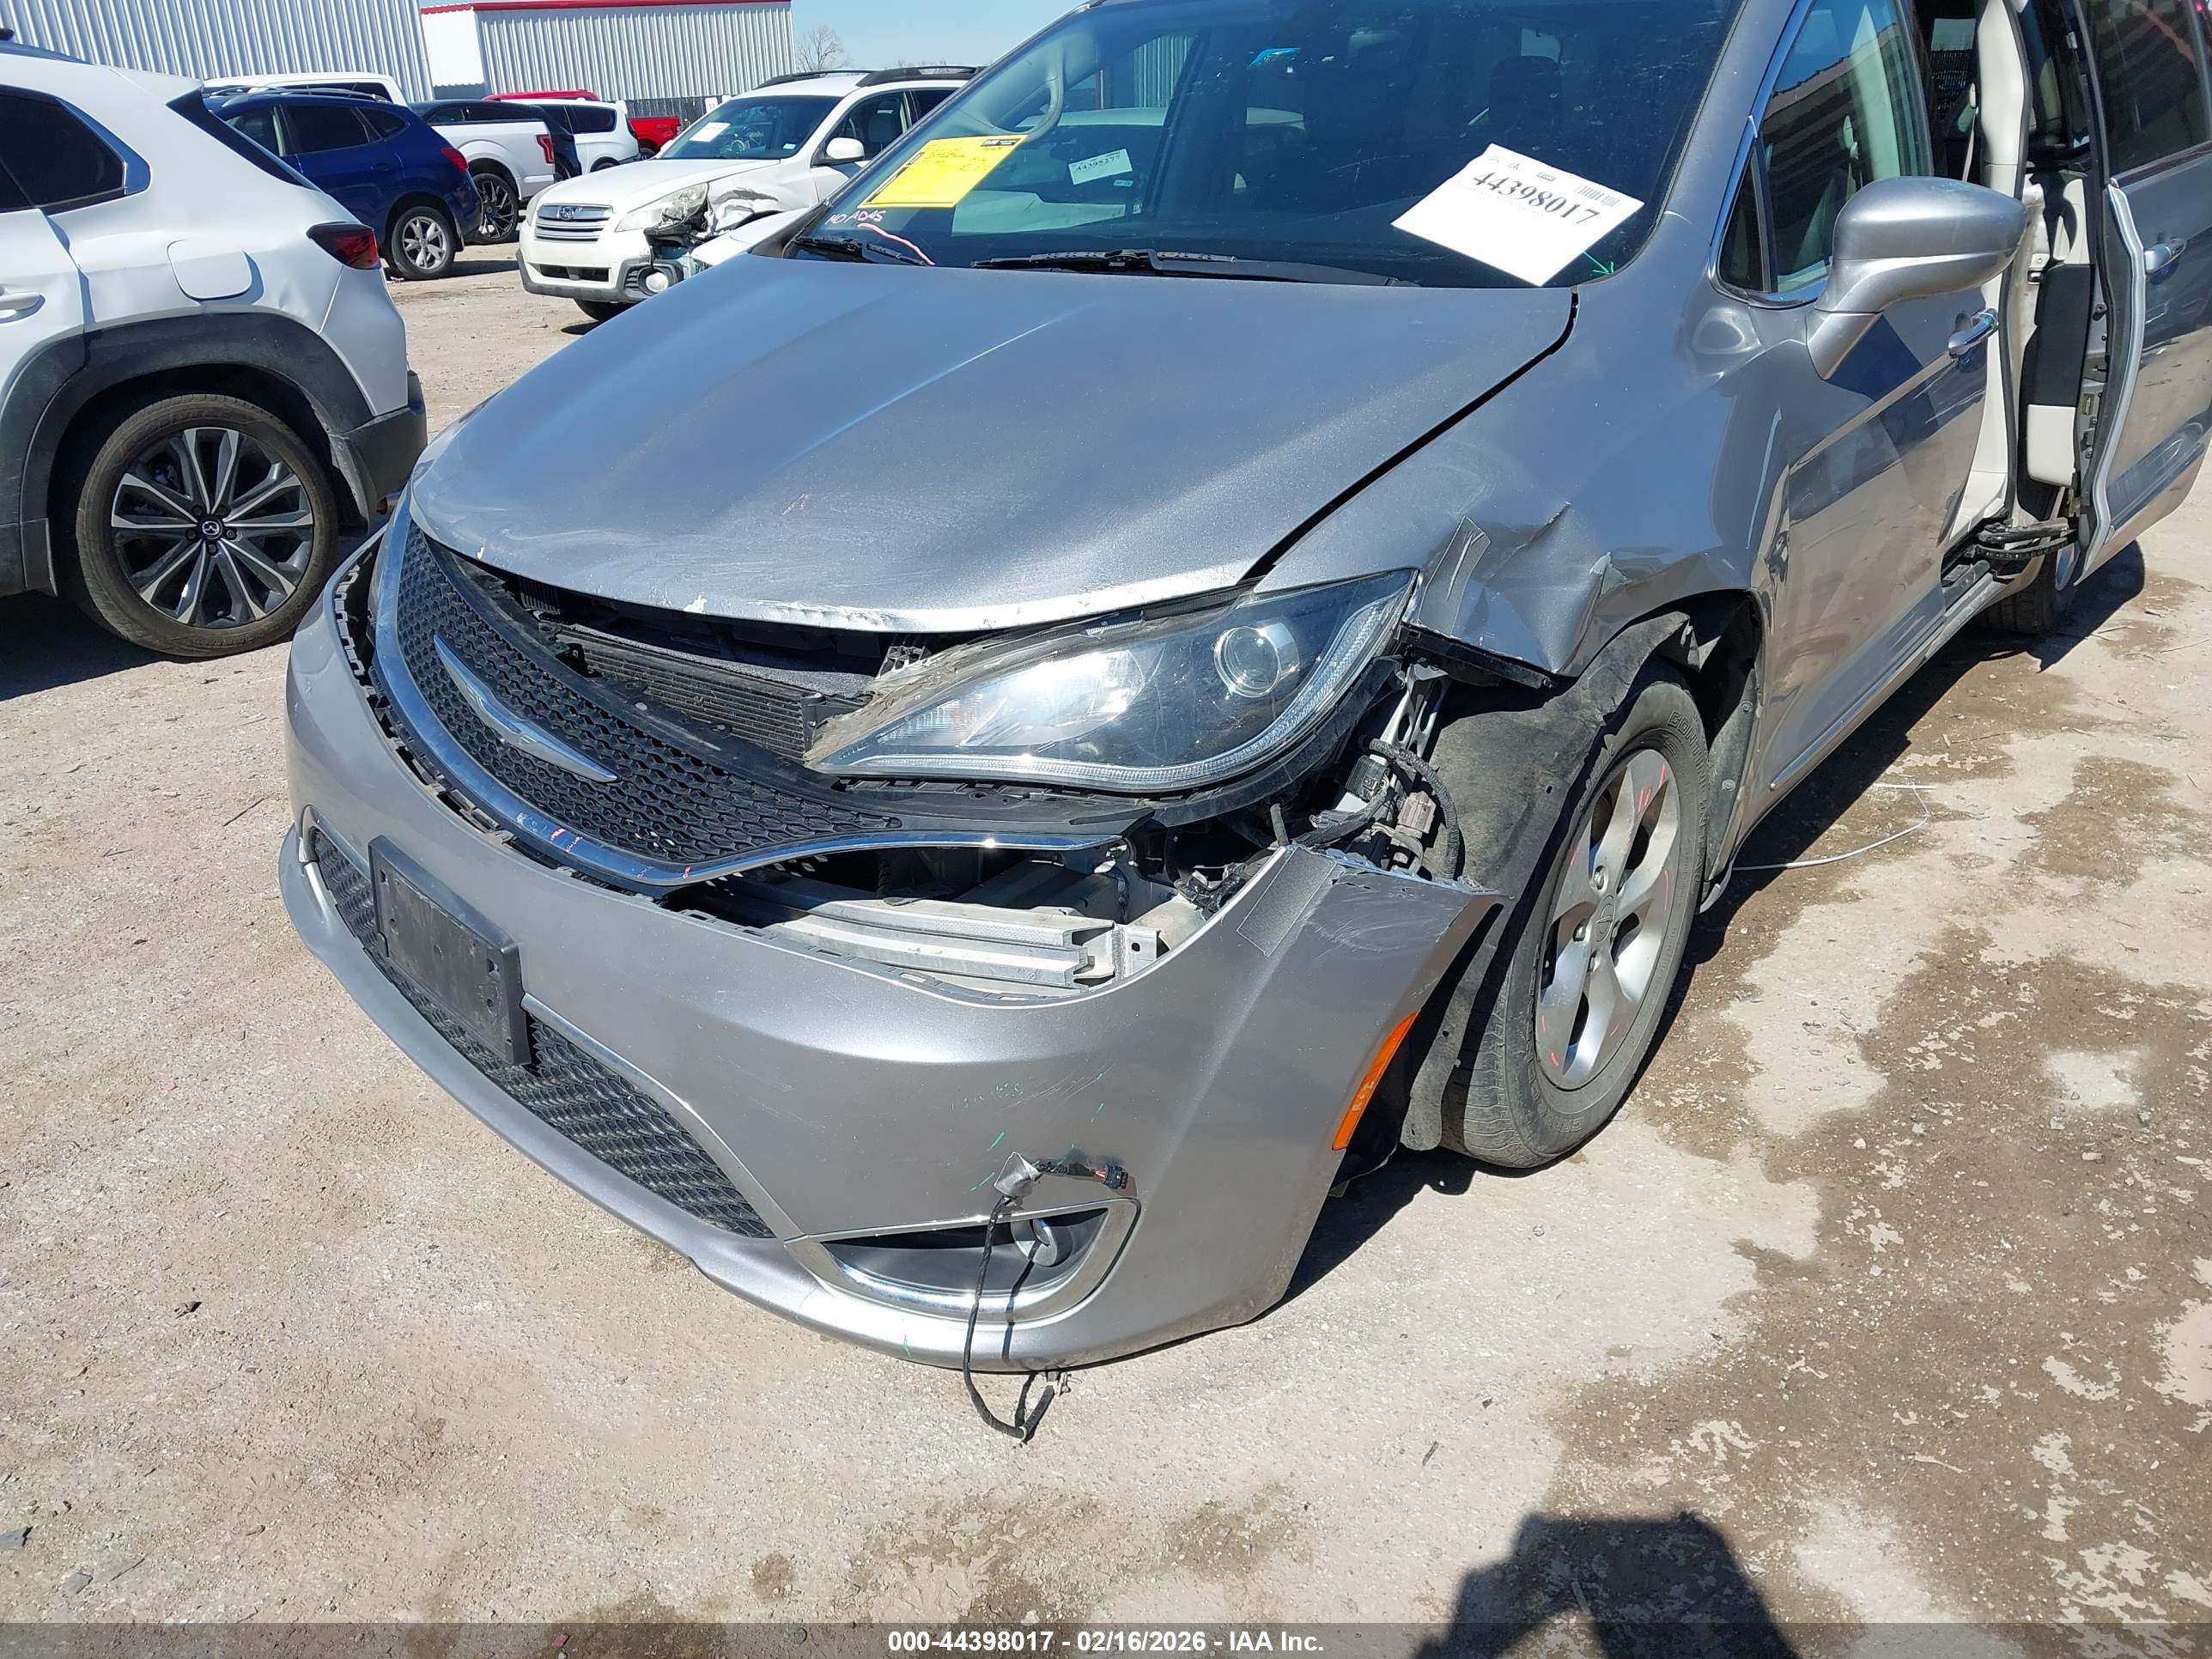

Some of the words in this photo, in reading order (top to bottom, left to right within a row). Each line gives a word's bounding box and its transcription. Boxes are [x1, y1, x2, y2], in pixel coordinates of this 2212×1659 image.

[1472, 172, 1601, 224] 44398017
[824, 213, 848, 226] NO
[843, 209, 887, 222] ADAS
